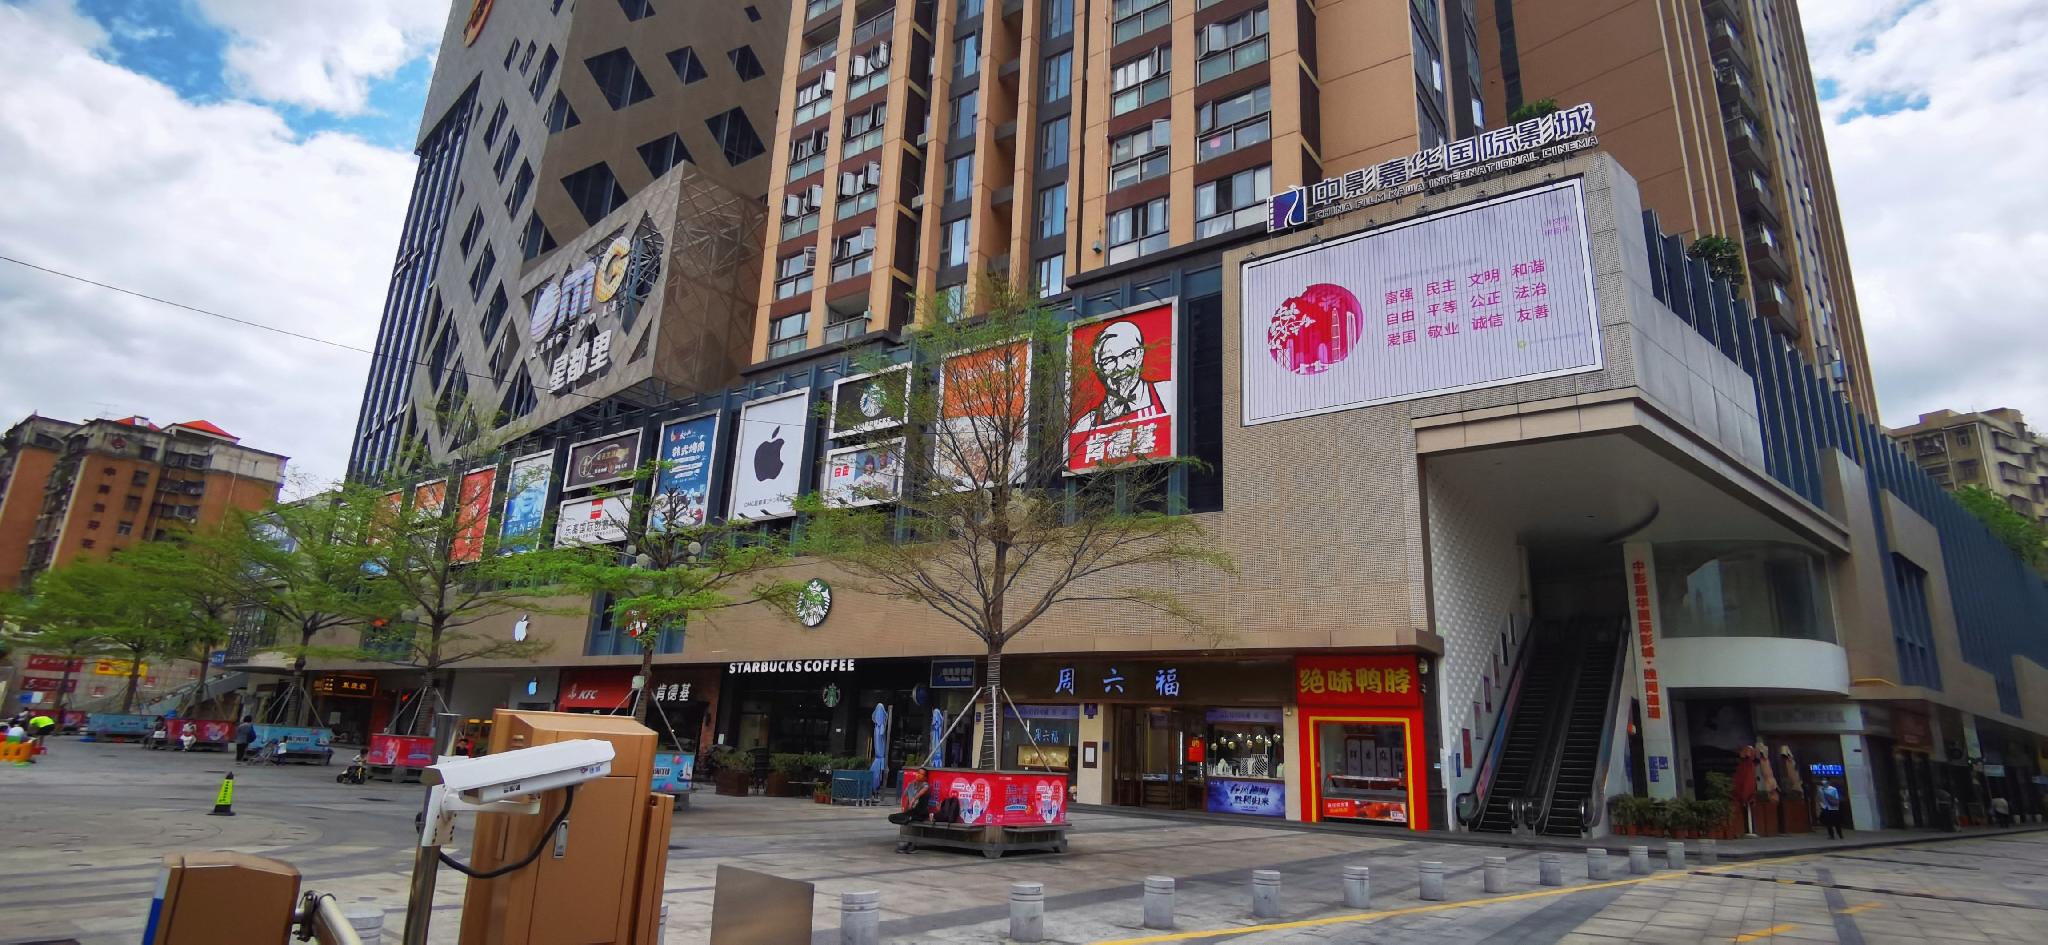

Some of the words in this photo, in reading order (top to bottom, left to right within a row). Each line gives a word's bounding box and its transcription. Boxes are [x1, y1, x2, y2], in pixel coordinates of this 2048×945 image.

[1312, 103, 1595, 206] 中影嘉华国际影城
[1315, 203, 1352, 219] CHINA
[1355, 193, 1385, 209] FILM
[1388, 183, 1424, 200] KAWA
[1428, 151, 1540, 188] INTERNATIONAL
[1542, 136, 1598, 158] CINEMA
[1385, 288, 1414, 305] 富强
[1426, 279, 1456, 296] 民主
[1468, 269, 1500, 287] 文明
[1512, 259, 1545, 278] 和谐
[1387, 310, 1414, 326] 自由
[1427, 300, 1457, 317] 平等
[1470, 291, 1501, 309] 公正
[1514, 282, 1547, 299] 法治
[1387, 330, 1416, 347] 爱国
[1428, 321, 1459, 339] 敬业
[1472, 314, 1504, 330] 诚信
[1517, 304, 1550, 323] 友善
[547, 329, 612, 394] 星都里
[1085, 423, 1157, 463] 肯德基
[729, 661, 802, 674] STARBUCKS
[804, 659, 855, 672] COFFEE
[1056, 667, 1180, 697] 周六福
[1300, 667, 1411, 694] 绝味鸭脖
[578, 689, 598, 700] KFC
[656, 683, 691, 701] 肯德基
